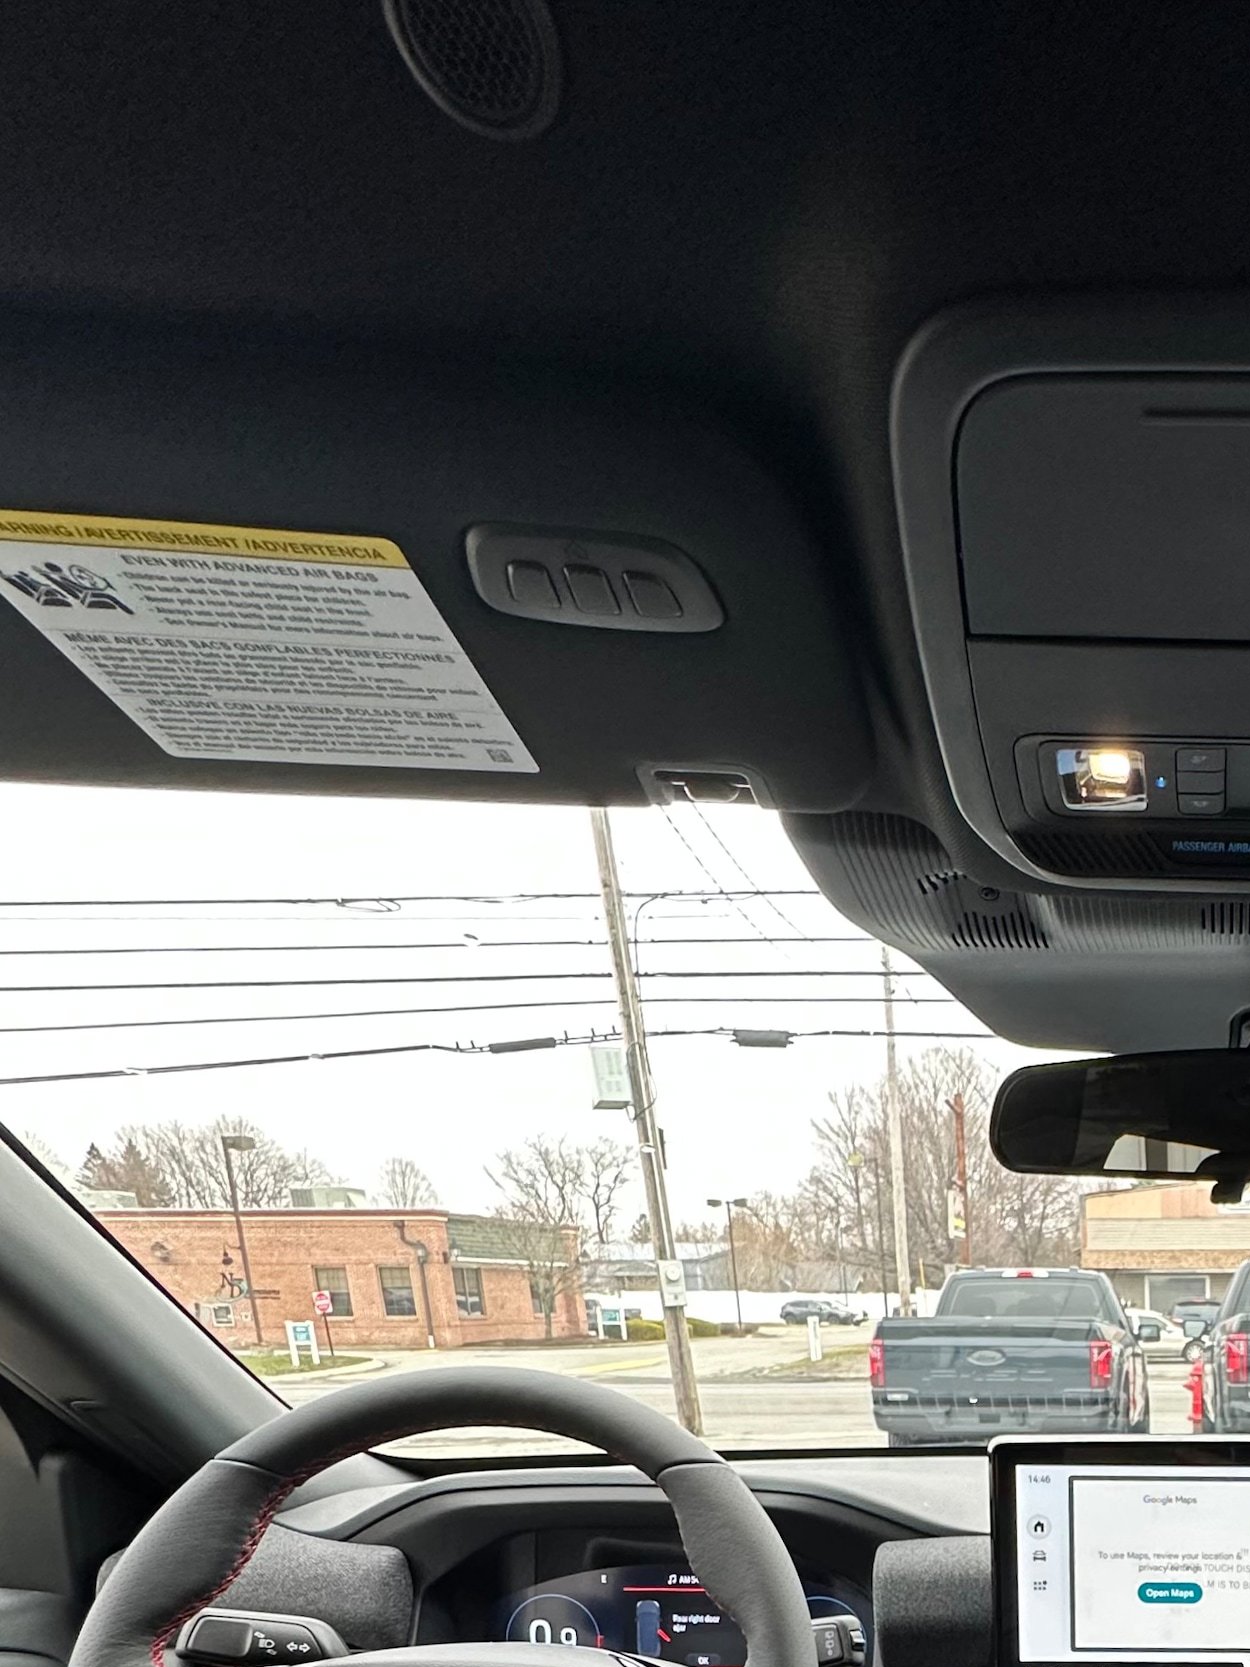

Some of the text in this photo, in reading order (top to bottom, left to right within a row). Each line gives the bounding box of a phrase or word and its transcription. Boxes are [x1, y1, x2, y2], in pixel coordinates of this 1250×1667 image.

[0, 521, 71, 538] ARNING
[120, 554, 378, 583] EVEN WITH ADVANCED AIR BAGS
[113, 636, 154, 648] AVEC
[155, 638, 188, 649] DES
[190, 639, 231, 651] SACS
[233, 642, 333, 657] GONFLABLES
[223, 700, 255, 711] CON
[257, 702, 286, 713] LAS
[287, 704, 342, 716] NUEVAS
[403, 709, 423, 719] DE
[1172, 841, 1225, 852] PASSENGER
[1143, 1495, 1198, 1506] Google Maps
[1098, 1551, 1109, 1560] To
[1110, 1553, 1125, 1561] use
[1153, 1552, 1179, 1561] review
[1181, 1552, 1199, 1562] your
[1201, 1551, 1233, 1561] location
[1138, 1563, 1167, 1574] privacy
[1204, 1563, 1234, 1573] TOUCH
[1217, 1580, 1226, 1588] IS
[1229, 1580, 1240, 1589] TO
[1145, 1588, 1195, 1600] Open Maps
[529, 1619, 551, 1644] 0
[698, 1656, 709, 1665] OK
